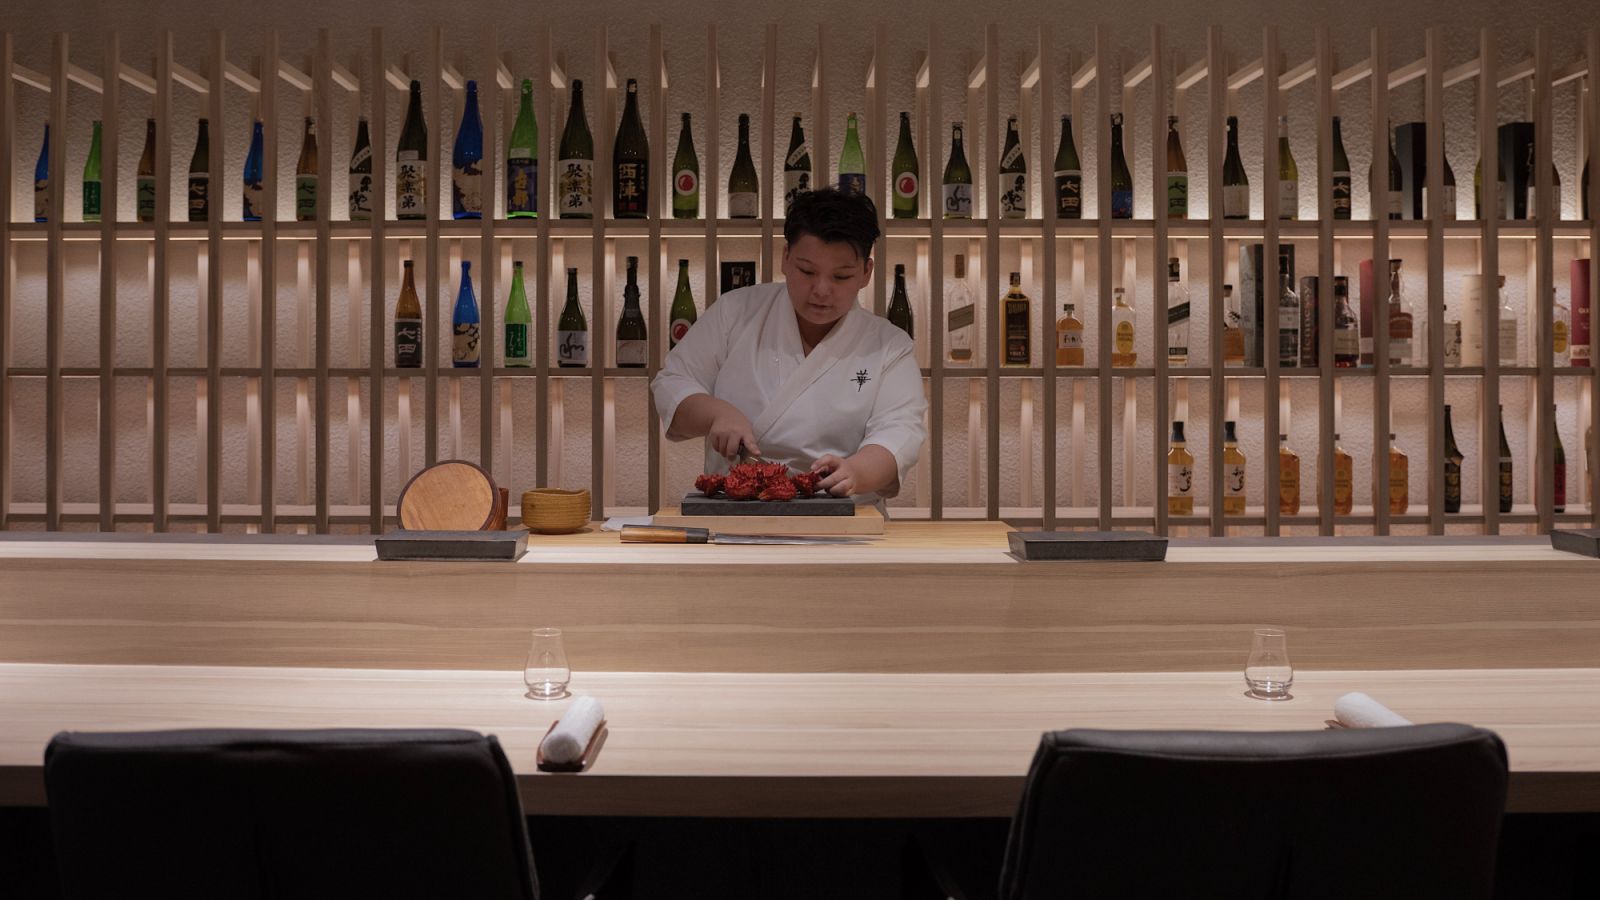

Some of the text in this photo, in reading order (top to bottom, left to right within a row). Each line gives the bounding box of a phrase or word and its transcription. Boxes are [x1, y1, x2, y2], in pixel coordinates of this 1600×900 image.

[567, 163, 583, 209] 聚楽第
[618, 163, 640, 200] 西陣
